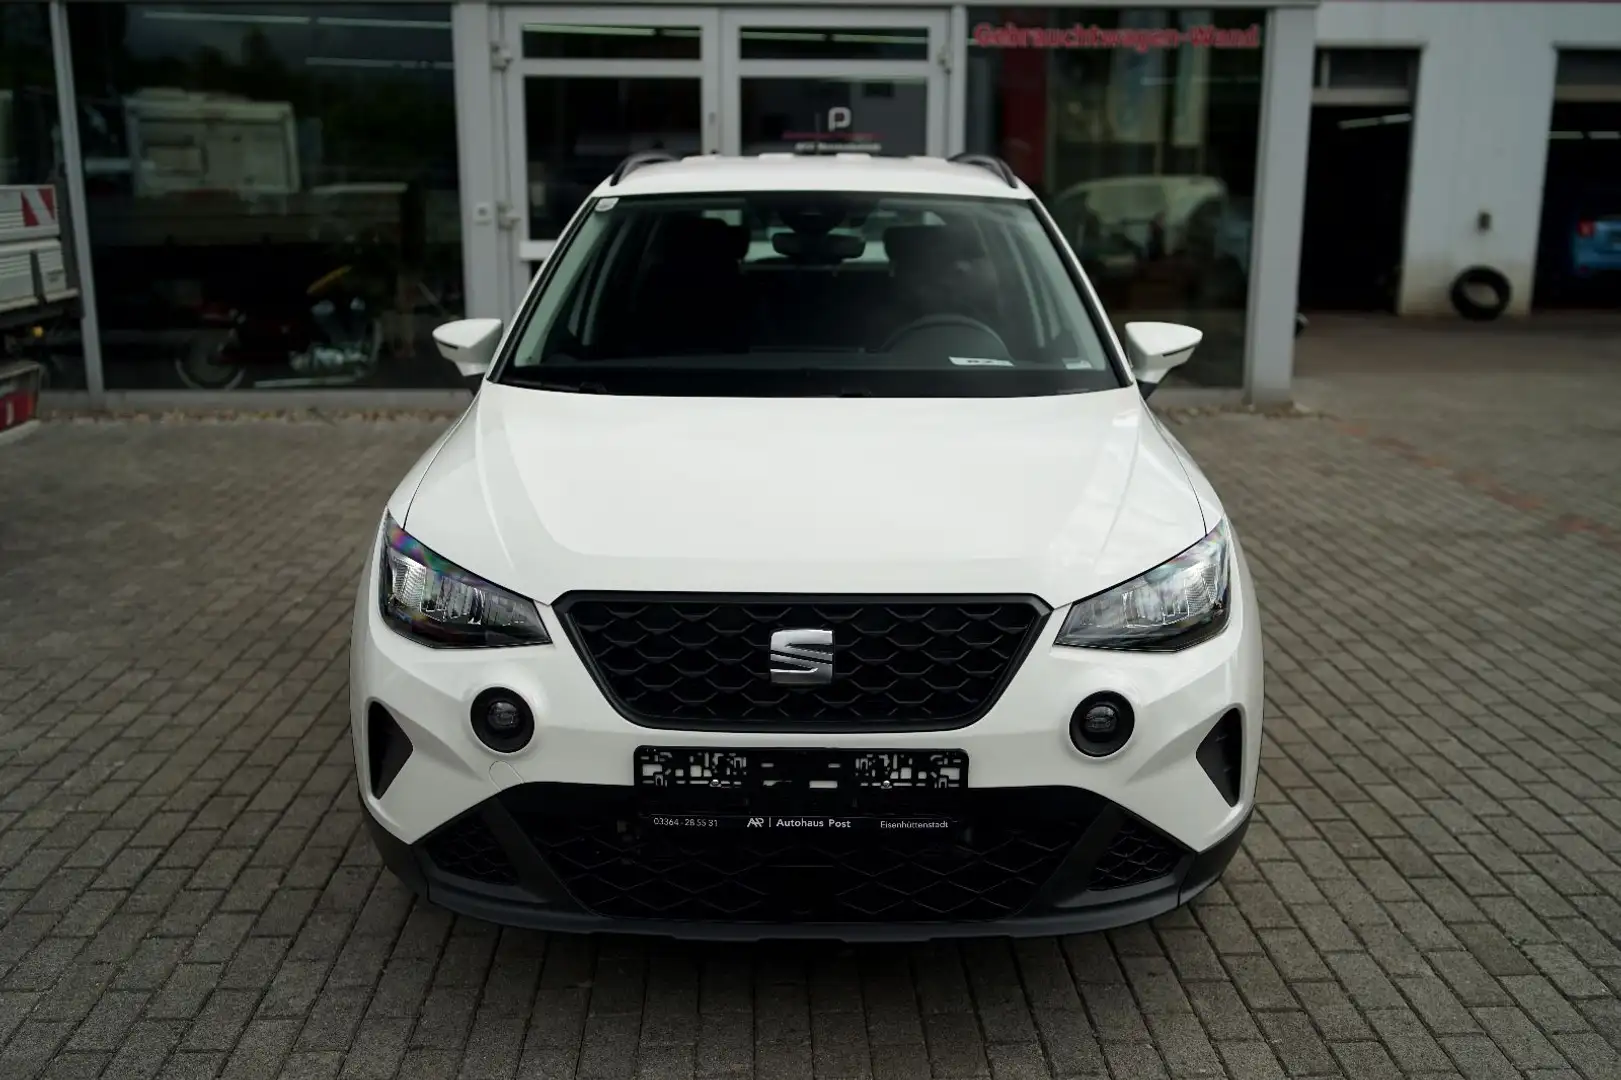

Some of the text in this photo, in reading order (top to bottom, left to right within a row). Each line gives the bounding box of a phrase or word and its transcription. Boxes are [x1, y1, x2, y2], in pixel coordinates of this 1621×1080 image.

[708, 819, 718, 828] 31
[776, 817, 825, 828] Autohaus
[828, 818, 852, 829] Post
